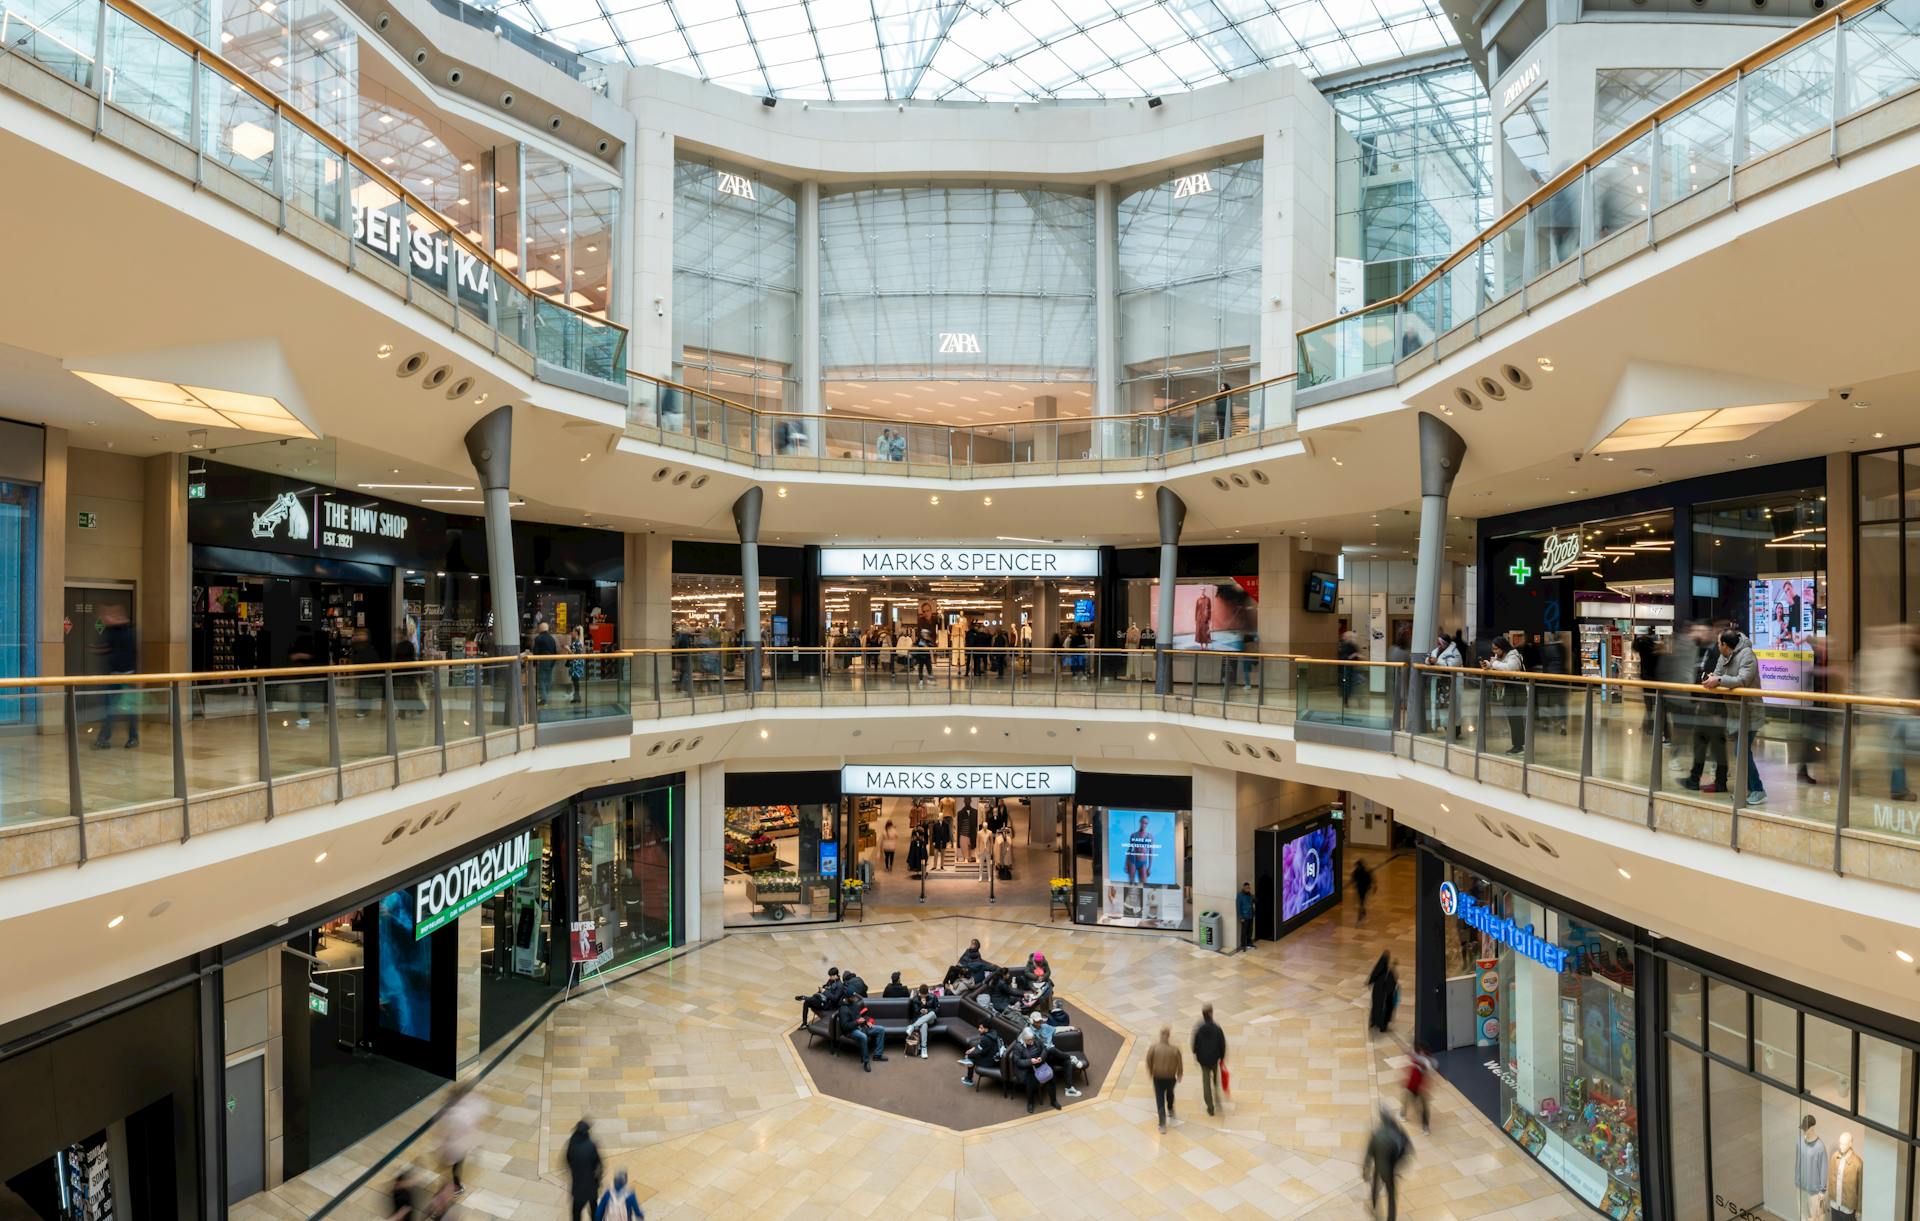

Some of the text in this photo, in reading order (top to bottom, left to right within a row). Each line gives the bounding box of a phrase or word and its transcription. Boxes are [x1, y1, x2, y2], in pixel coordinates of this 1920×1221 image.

[718, 171, 757, 201] ZARA
[1174, 172, 1214, 199] ZARA
[938, 332, 982, 353] ZARA
[323, 501, 409, 539] THE HMV SHOP
[862, 553, 1057, 571] MARKS & SPENCER
[1539, 533, 1580, 573] Boots
[1395, 597, 1407, 605] LIFT
[1761, 664, 1789, 673] Foundation
[1776, 673, 1800, 683] matching
[866, 771, 1050, 789] MARKS & SPENCER
[416, 831, 531, 924] FOOTASYLUM
[1465, 895, 1569, 974] Entertainer
[1715, 1194, 1738, 1215] S/S
